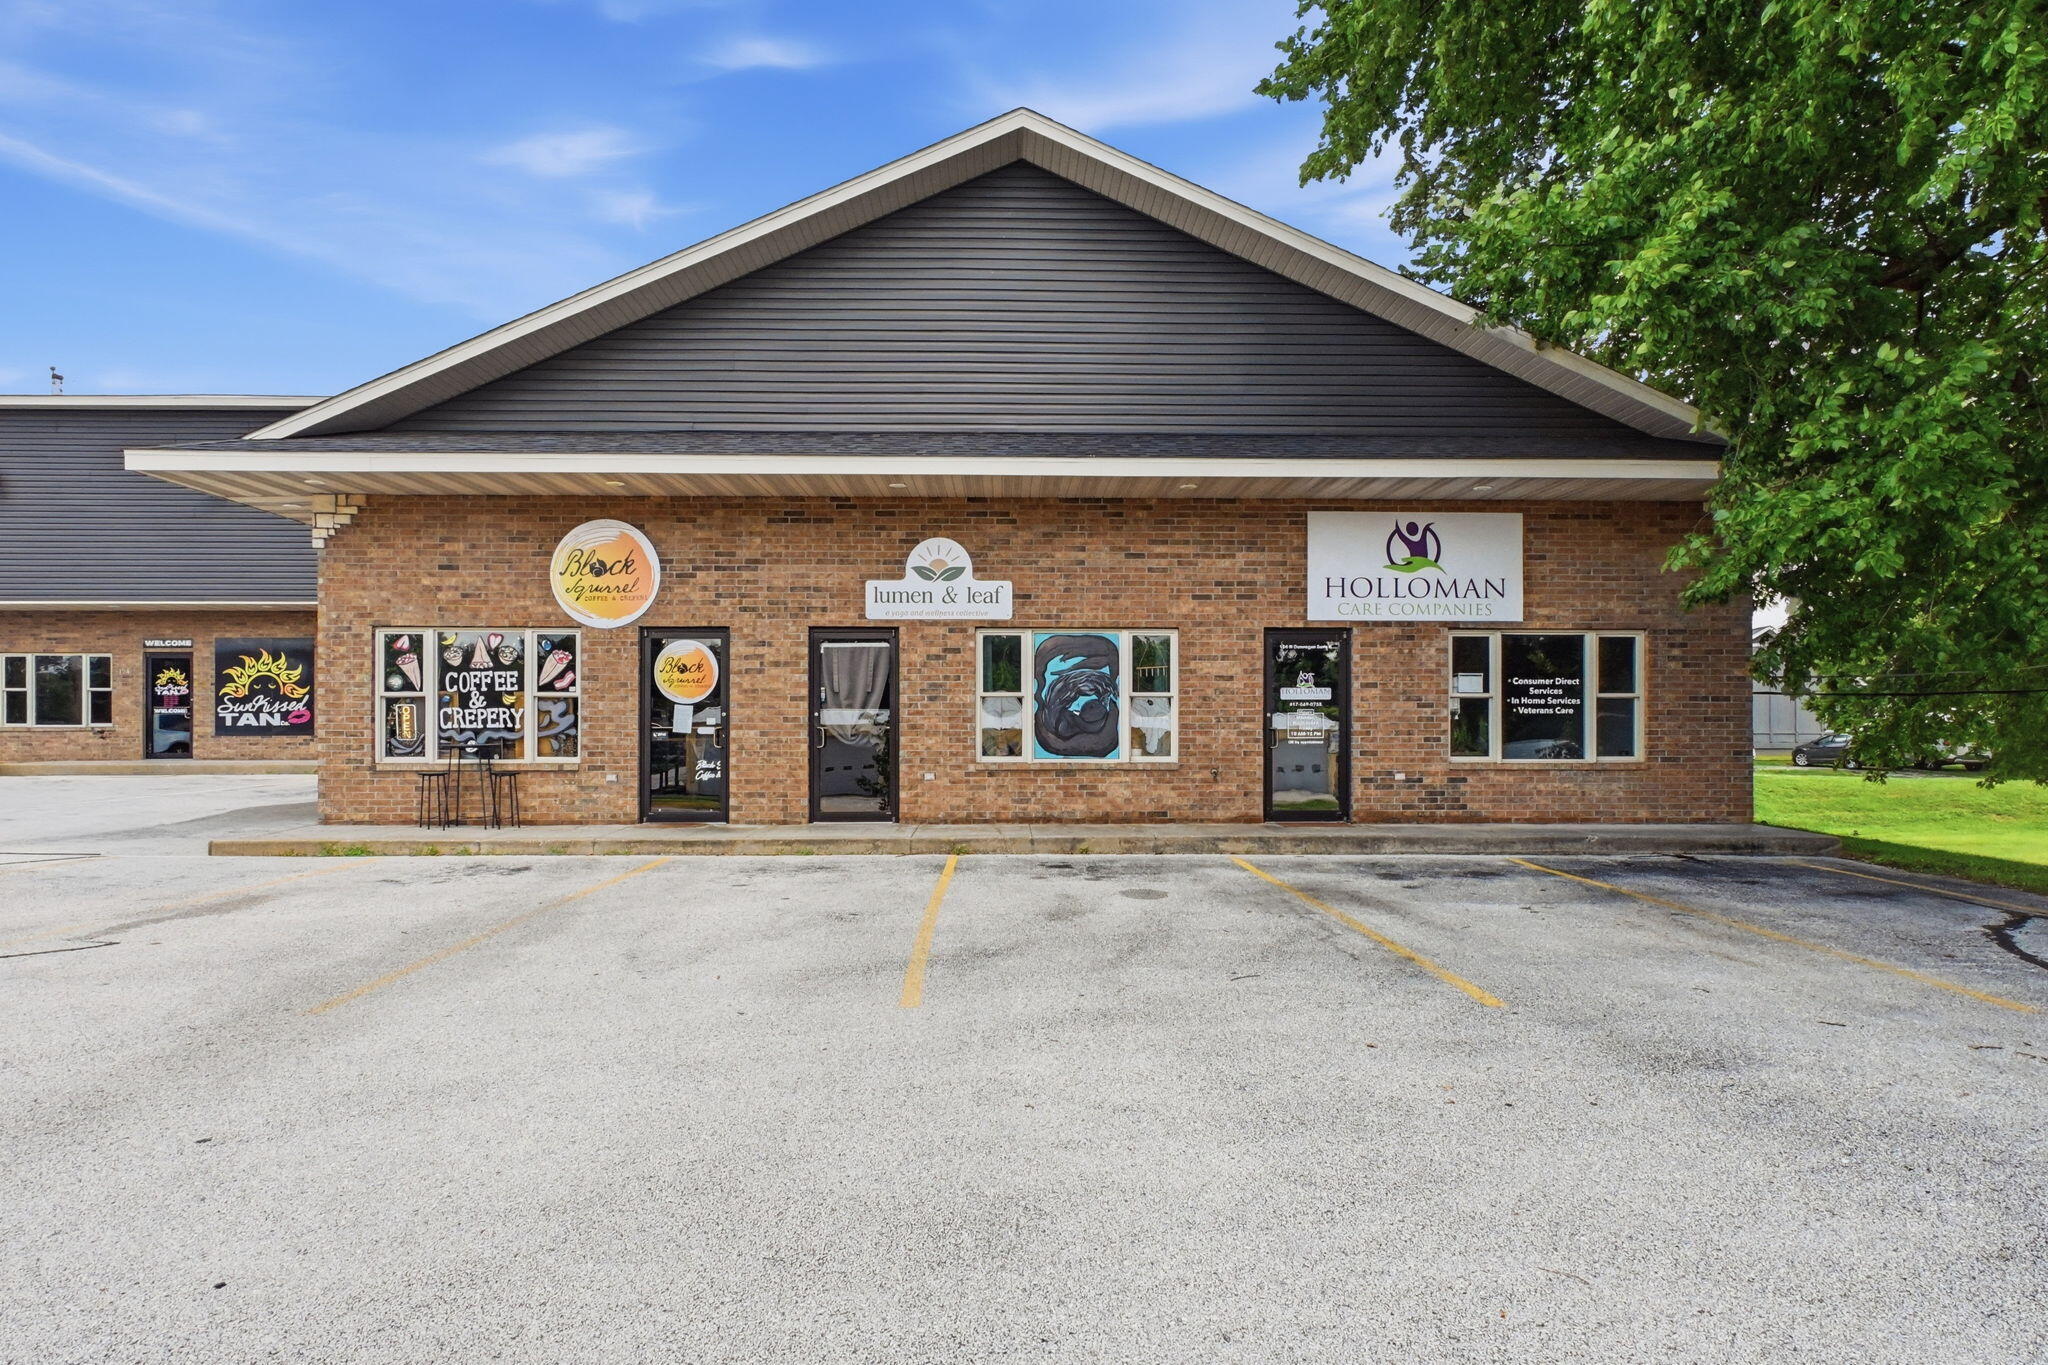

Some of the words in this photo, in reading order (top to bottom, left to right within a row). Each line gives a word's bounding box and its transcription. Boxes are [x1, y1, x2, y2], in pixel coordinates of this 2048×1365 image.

[565, 577, 640, 601] Squirrel
[874, 586, 933, 604] lumen
[942, 585, 958, 604] &
[967, 585, 1004, 604] leaf
[1325, 577, 1506, 599] HOLLOMAN
[891, 610, 910, 618] yoga
[1337, 602, 1381, 616] CARE
[1388, 602, 1492, 616] COMPANIES
[444, 670, 519, 693] COFFEE
[1513, 677, 1554, 685] Consumer
[1555, 677, 1580, 685] Direct
[468, 690, 487, 709] &
[1529, 687, 1563, 695] Services
[217, 694, 310, 713] SunKissed
[1511, 697, 1519, 705] In
[1524, 697, 1546, 705] Home
[1547, 697, 1581, 705] Services
[219, 712, 281, 726] TAN
[440, 707, 524, 729] CREPERY
[1518, 707, 1553, 715] Veterans
[1555, 707, 1574, 715] Care
[403, 705, 411, 739] OPEN
